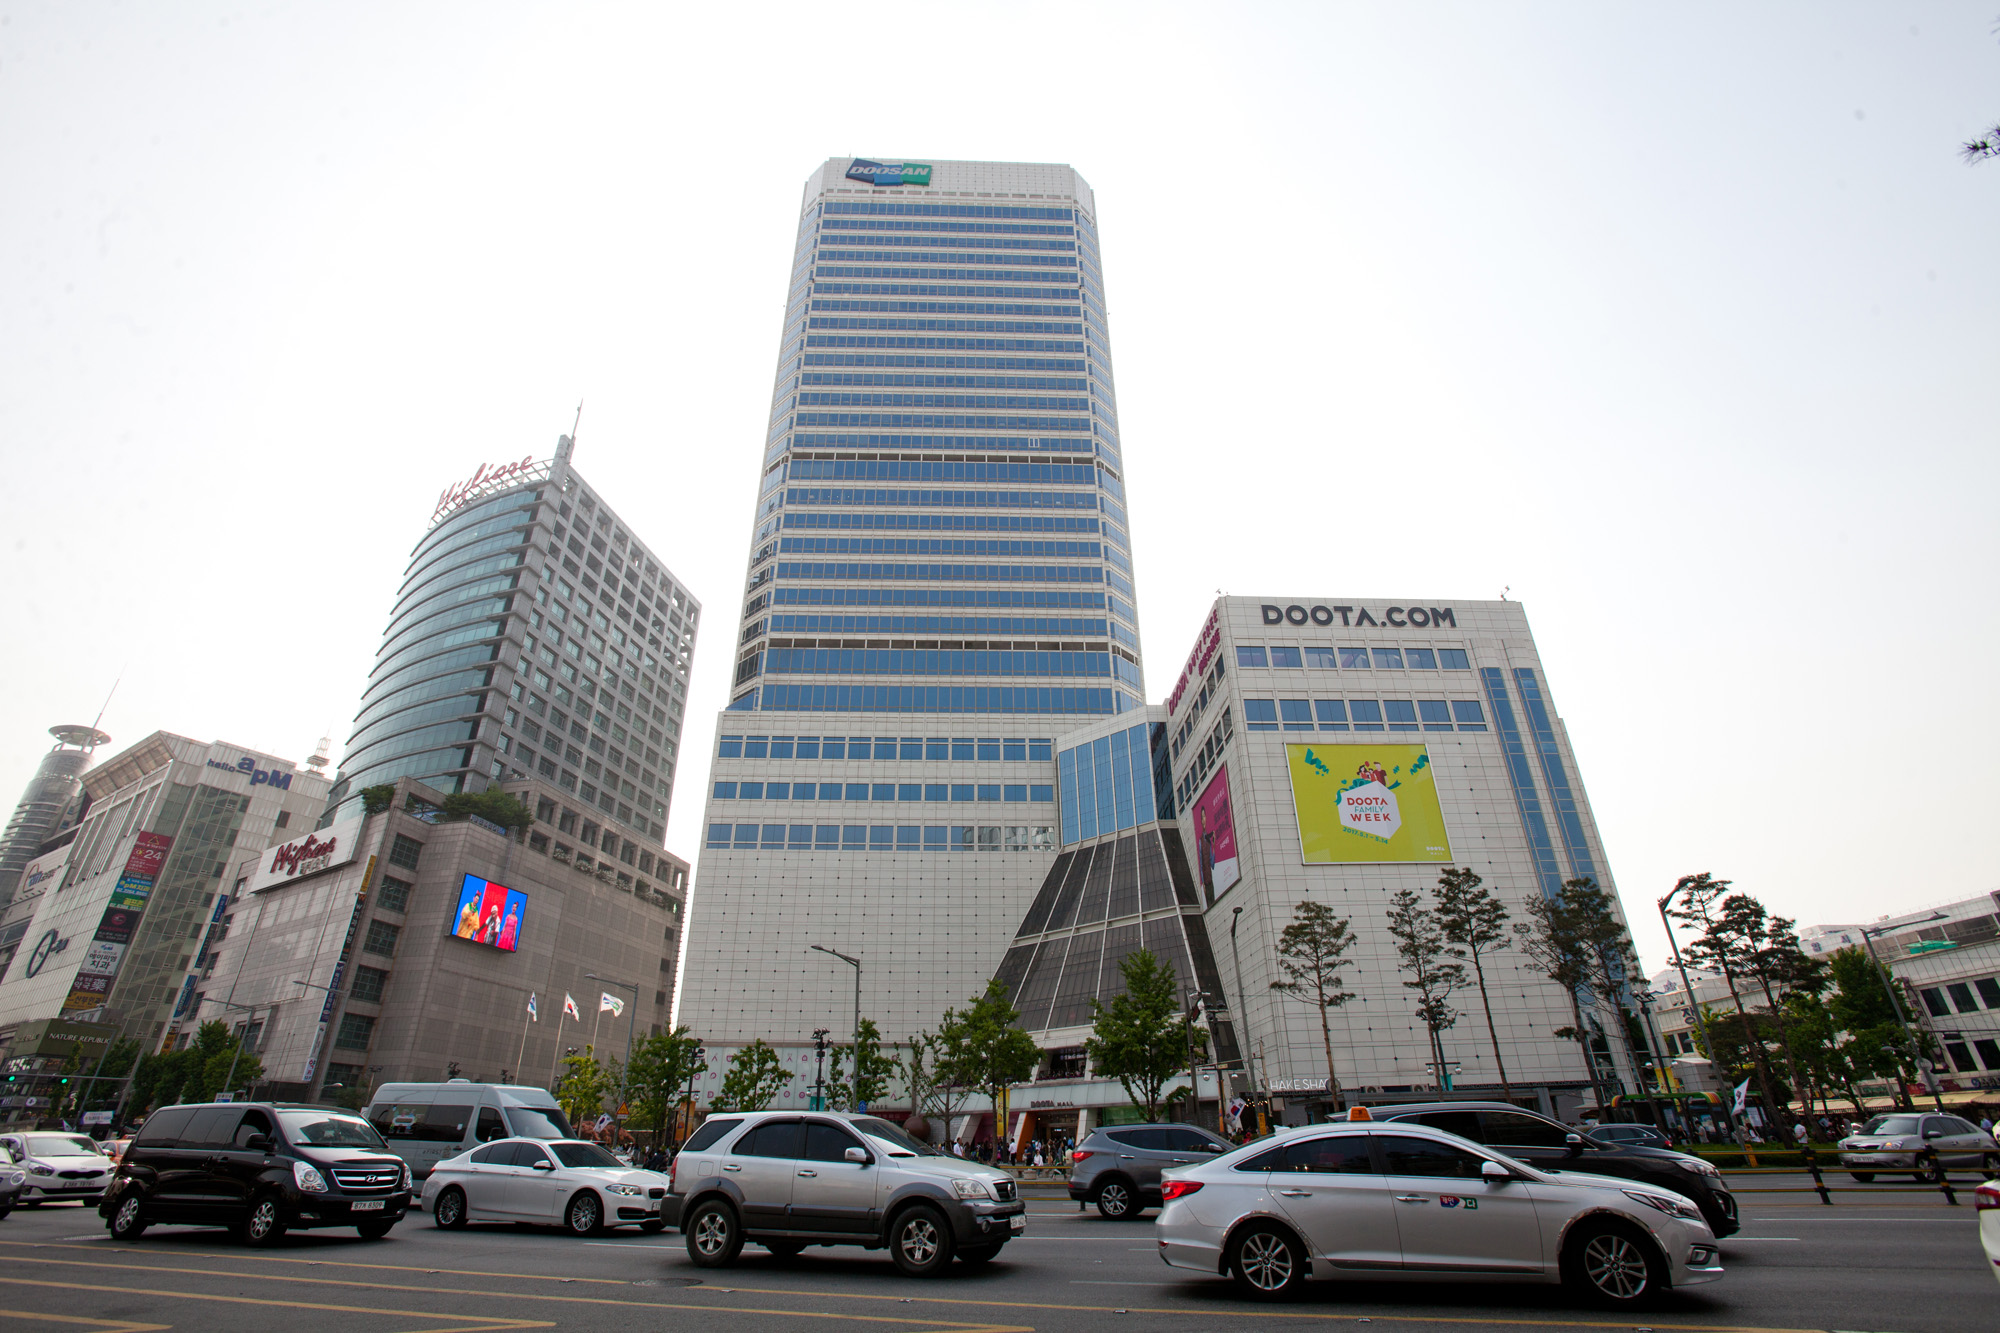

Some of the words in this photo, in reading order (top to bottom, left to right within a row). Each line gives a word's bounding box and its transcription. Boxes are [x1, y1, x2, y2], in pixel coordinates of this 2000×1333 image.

[849, 166, 930, 176] DOOSAN
[1261, 604, 1457, 628] DOOTA.COM
[1168, 671, 1189, 717] DOOTA
[1188, 639, 1202, 675] DUTY
[1202, 608, 1218, 645] FREE
[206, 758, 235, 773] hello
[238, 756, 293, 791] apM
[1346, 797, 1388, 806] DOOTA
[1354, 805, 1385, 814] FAMILY
[1350, 813, 1392, 822] WEEK
[1342, 826, 1369, 839] 2017.5.1
[1375, 835, 1388, 844] 5.14
[144, 849, 162, 860] 24
[269, 833, 337, 876] Migliore
[90, 960, 111, 970] 치과
[48, 1033, 78, 1041] NATURE
[80, 1035, 111, 1044] REPUBLIC
[1266, 1078, 1301, 1091] HAKE
[1031, 1100, 1054, 1108] DOOTA
[1441, 1196, 1455, 1206] 개인
